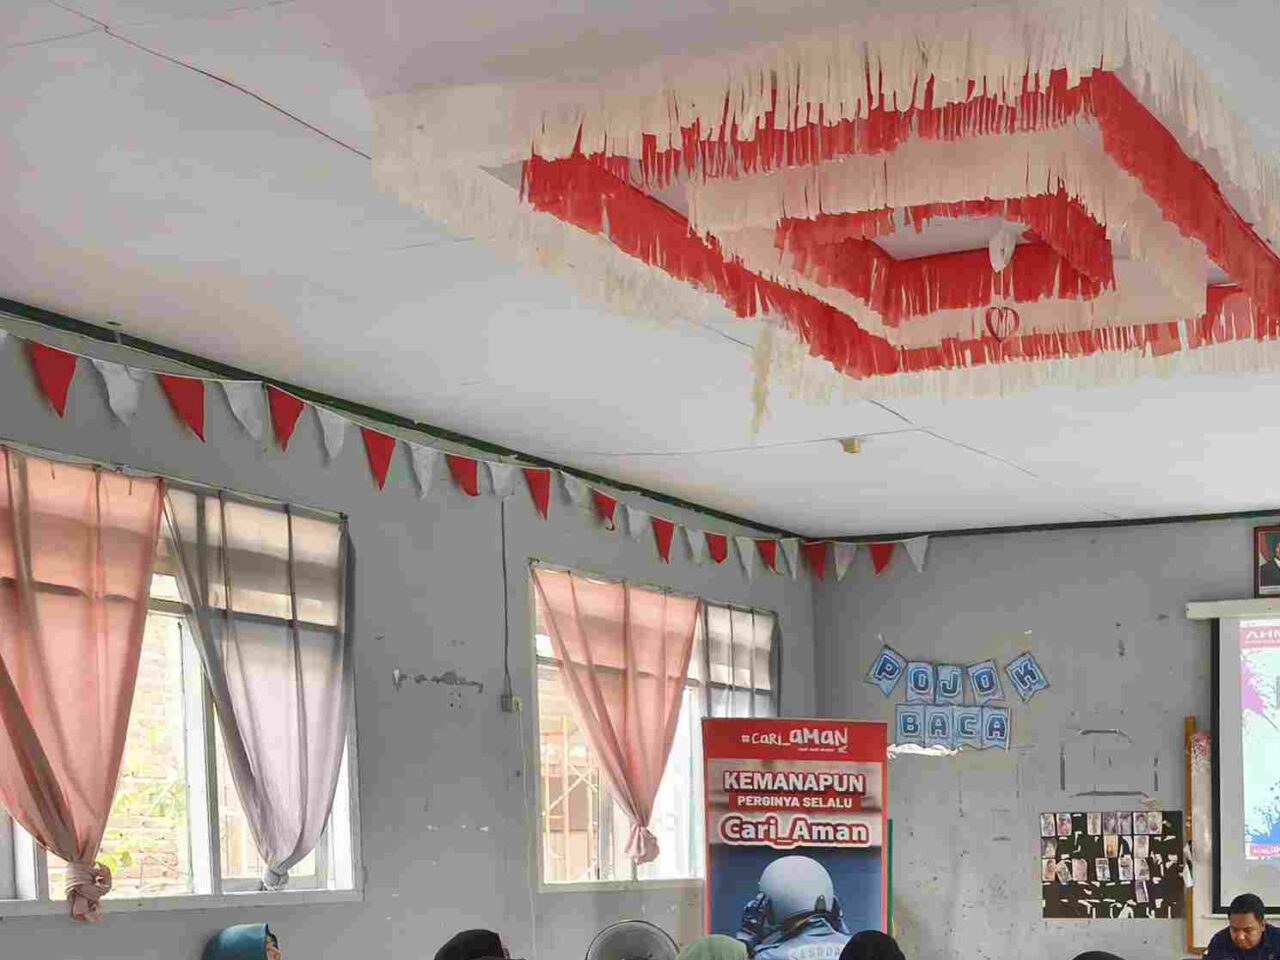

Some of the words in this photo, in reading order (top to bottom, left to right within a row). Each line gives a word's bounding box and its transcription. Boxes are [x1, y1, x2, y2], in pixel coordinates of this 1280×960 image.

[874, 653, 1039, 698] POJOK
[900, 711, 1009, 740] BACA
[724, 771, 865, 793] KEMANAPUN
[737, 795, 800, 807] PERGINYA
[802, 797, 853, 808] SELALU
[723, 817, 867, 843] Cari_Aman
